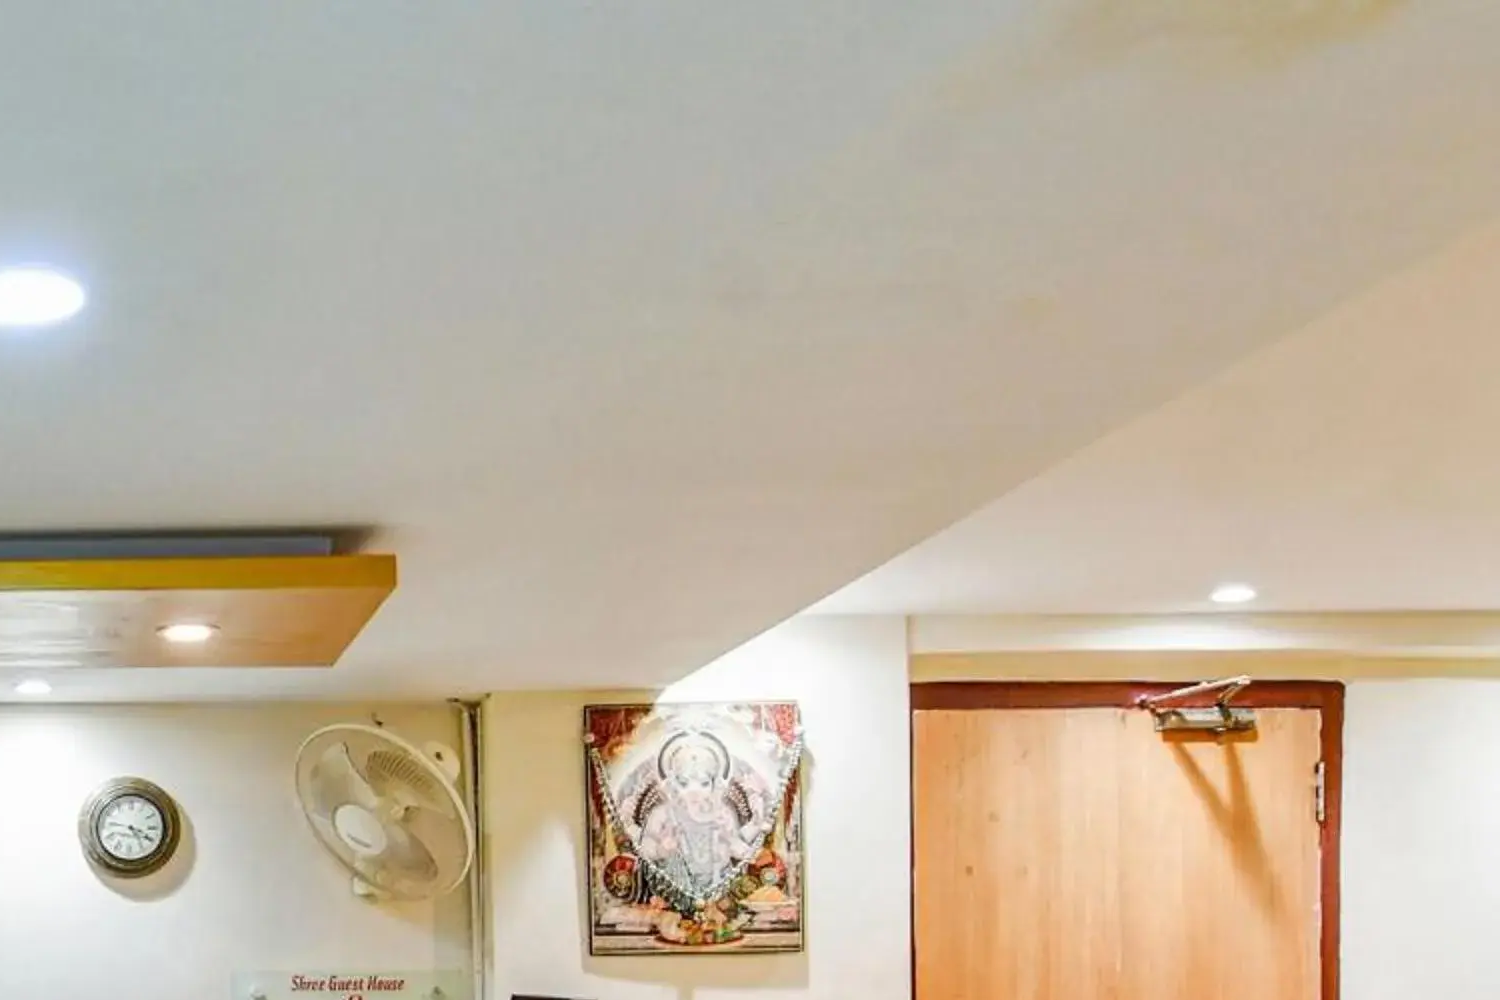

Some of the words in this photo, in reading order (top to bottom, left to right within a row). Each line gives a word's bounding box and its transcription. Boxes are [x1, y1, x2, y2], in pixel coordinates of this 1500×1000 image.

[291, 975, 326, 991] Shree
[328, 975, 364, 991] Guest
[367, 975, 405, 991] House
